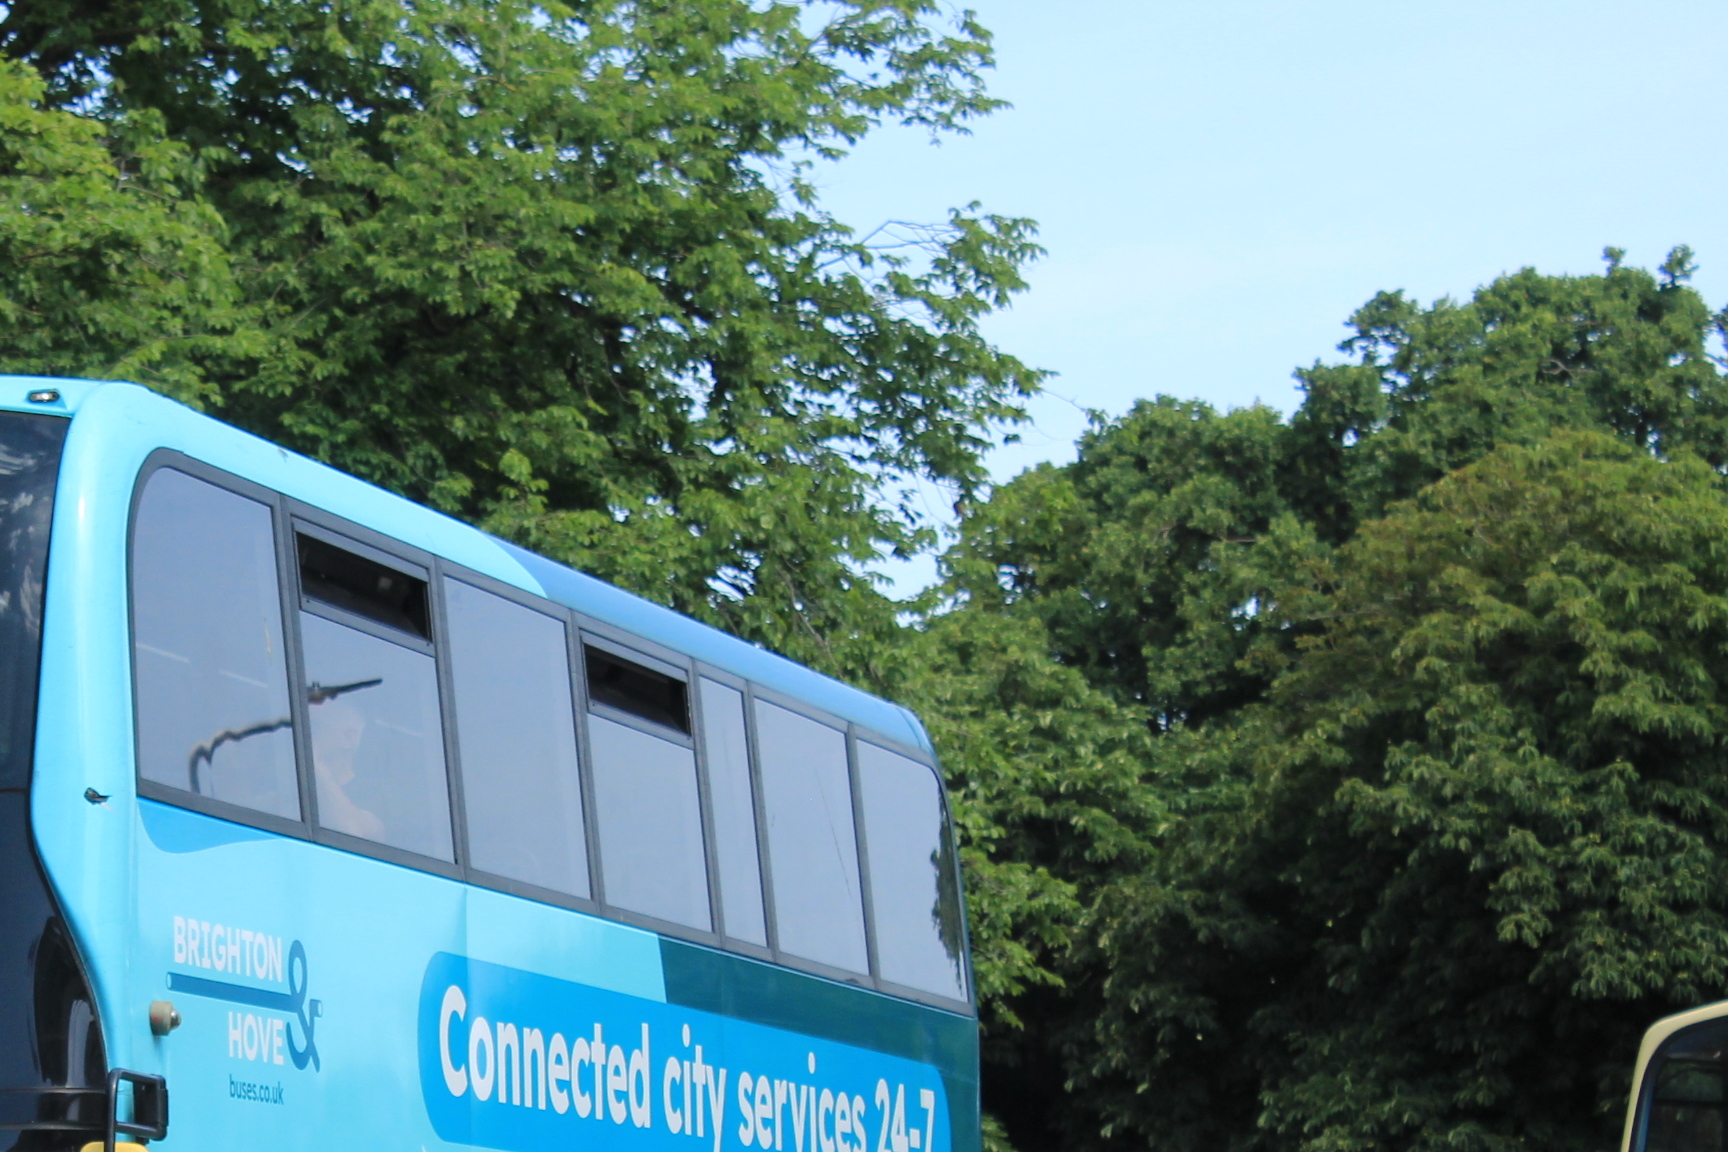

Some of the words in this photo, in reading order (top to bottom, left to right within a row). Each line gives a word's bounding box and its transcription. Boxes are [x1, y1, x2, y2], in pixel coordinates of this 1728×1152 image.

[173, 914, 283, 983] BRIGHTON
[228, 1010, 285, 1066] HOVE
[438, 984, 651, 1130] Connected
[228, 1073, 285, 1105] buses.co.uk
